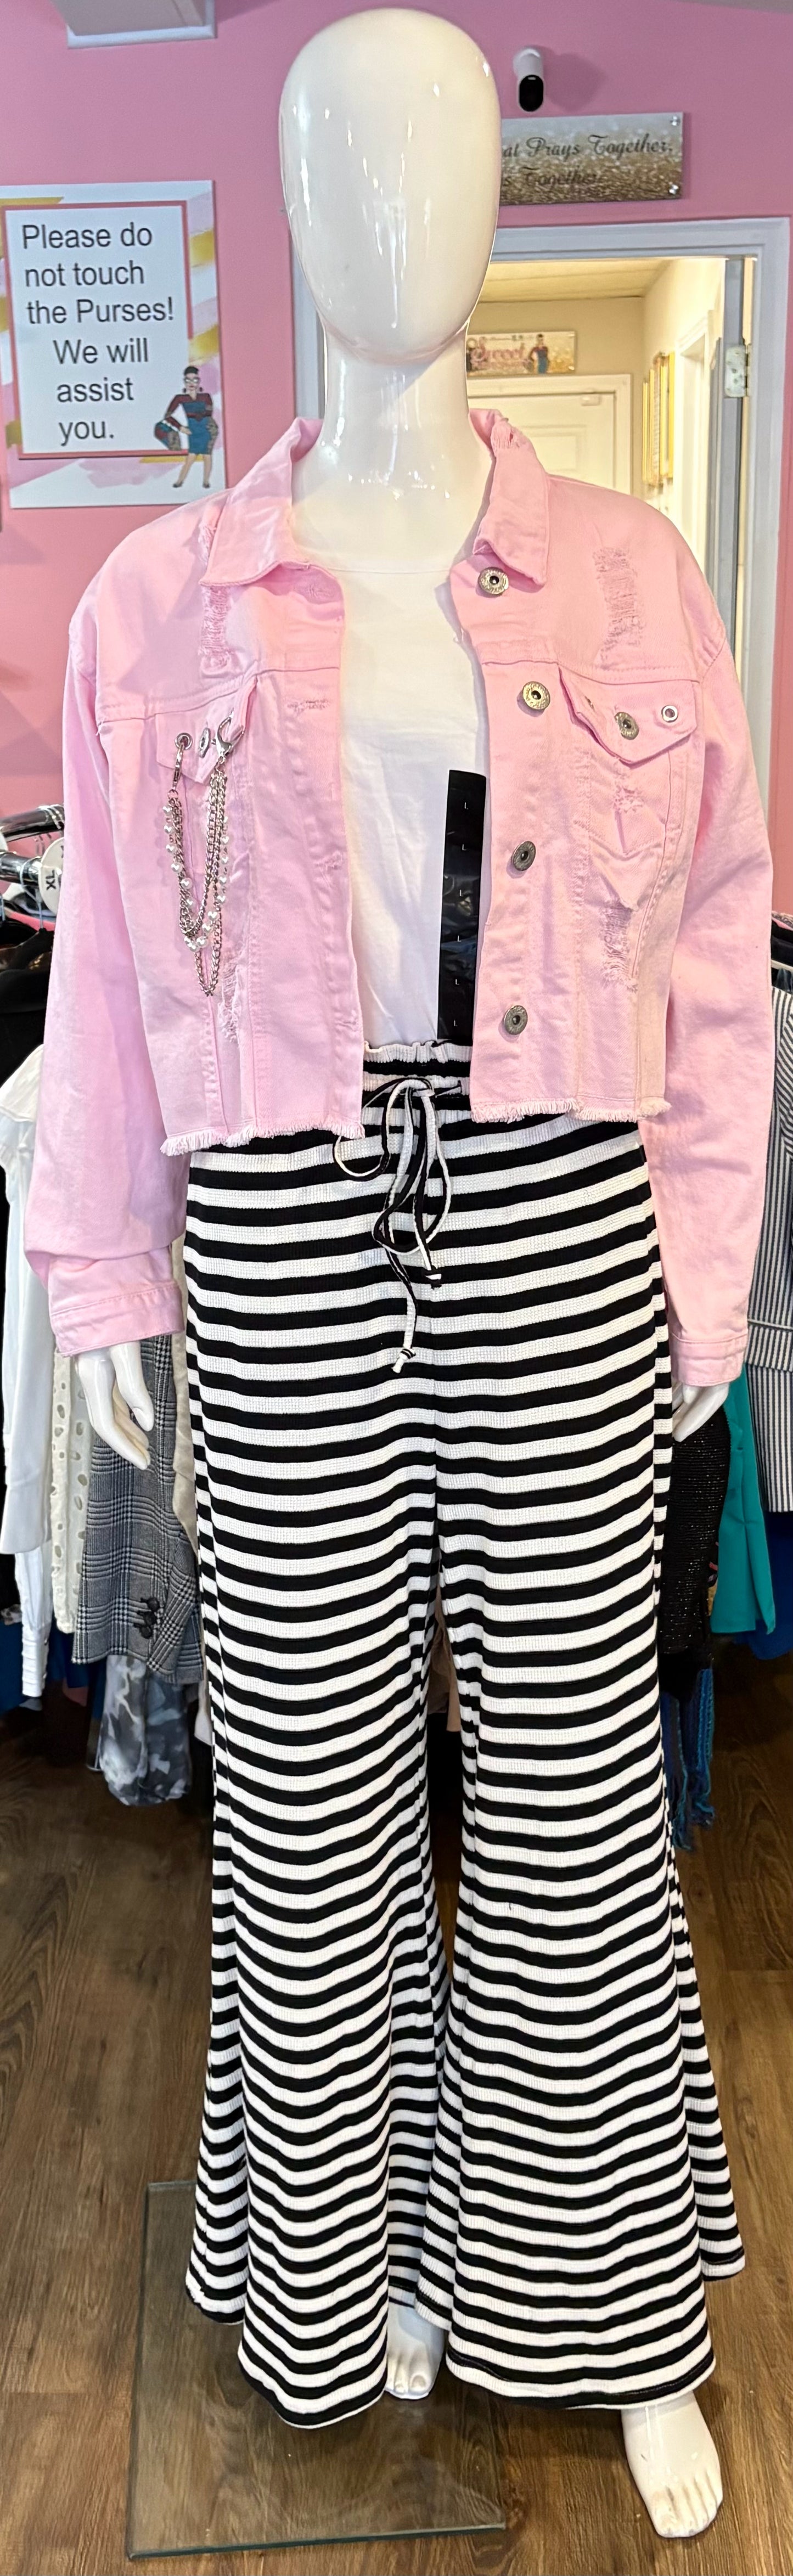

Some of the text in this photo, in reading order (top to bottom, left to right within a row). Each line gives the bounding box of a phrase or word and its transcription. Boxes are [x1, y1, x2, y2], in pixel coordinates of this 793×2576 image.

[526, 137, 580, 162] Prays
[23, 222, 153, 250] Please do
[25, 260, 144, 287] not touch
[27, 296, 173, 324] the Purses!
[53, 338, 148, 364] We will
[57, 376, 134, 403] assist
[59, 421, 114, 447] you.
[46, 870, 57, 891] XL
